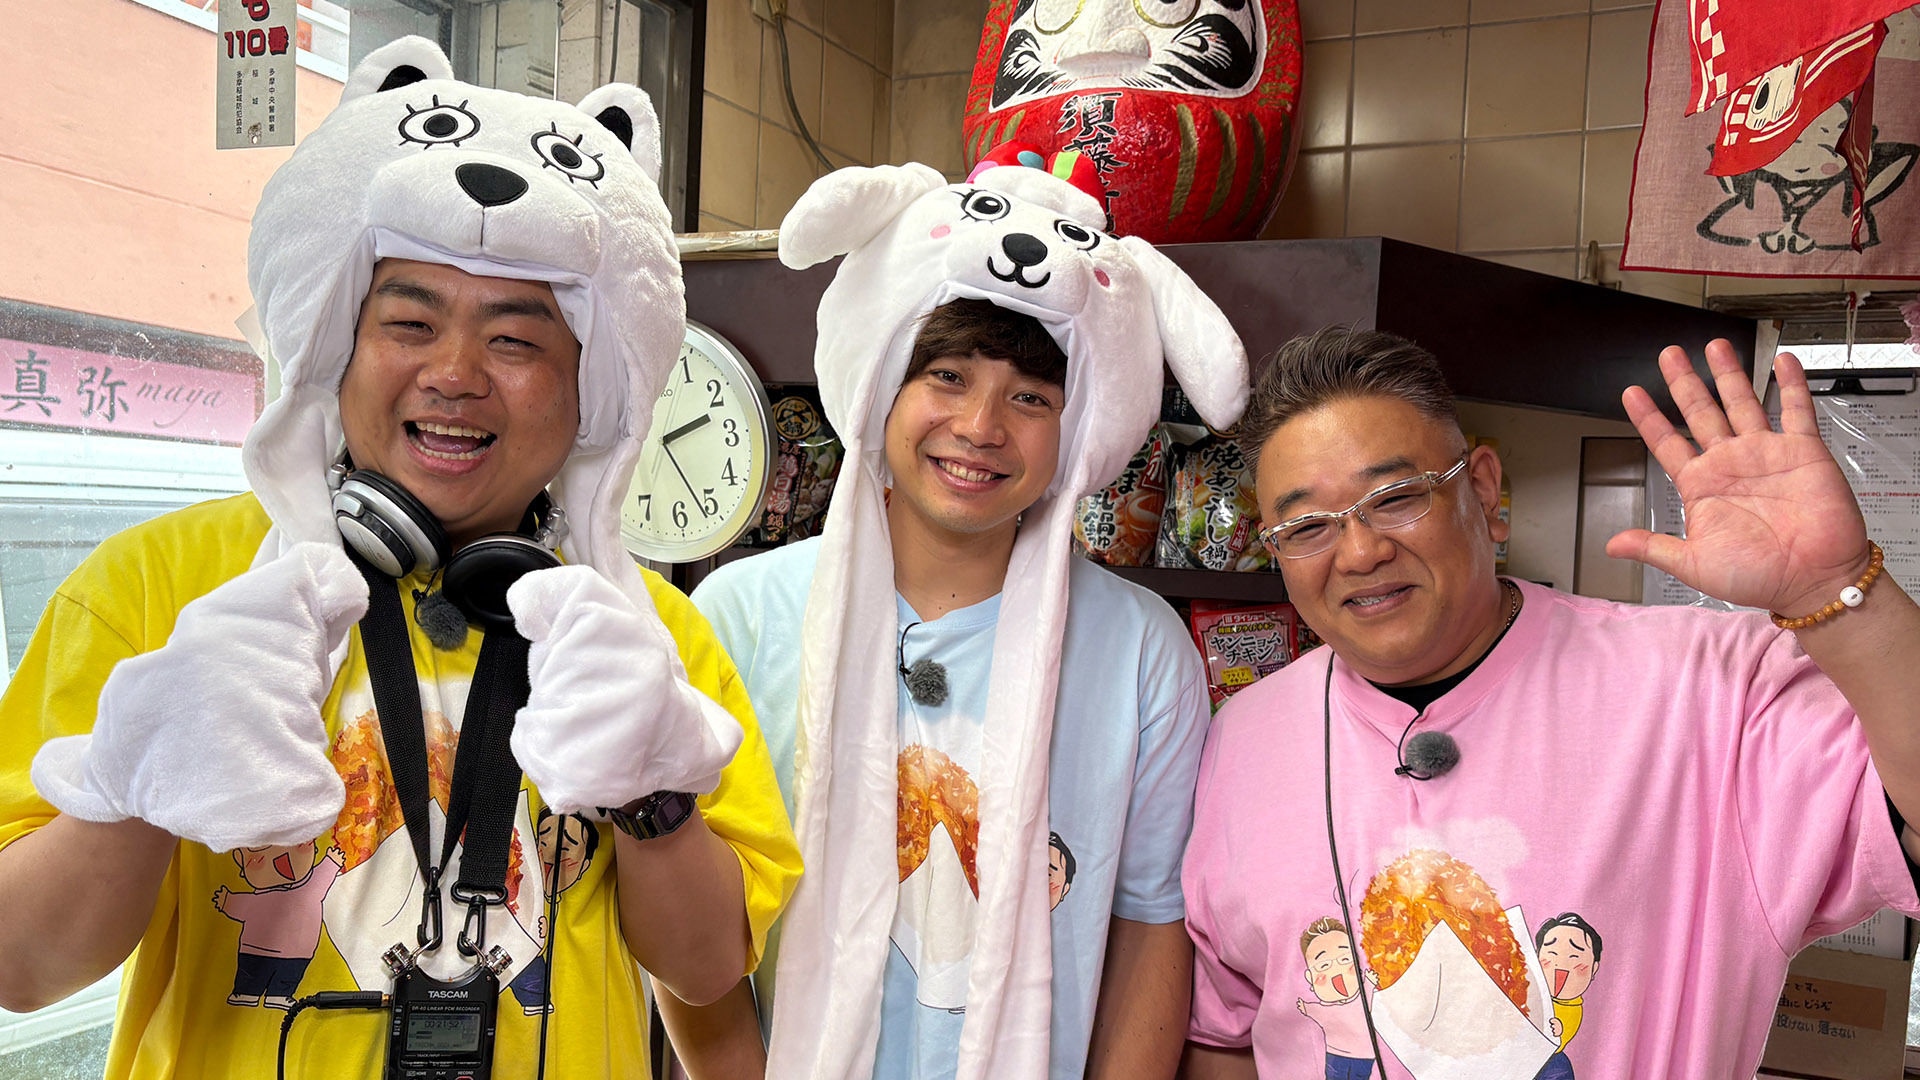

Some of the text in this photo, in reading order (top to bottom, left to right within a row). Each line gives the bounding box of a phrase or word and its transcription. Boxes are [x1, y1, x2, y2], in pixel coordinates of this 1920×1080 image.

[223, 26, 289, 59] 110番
[679, 356, 694, 384] 1
[136, 381, 226, 428] maya
[706, 379, 725, 408] 2
[723, 418, 740, 447] 3
[721, 457, 738, 486] 4
[638, 494, 651, 522] 7
[672, 501, 688, 529] 6
[702, 488, 719, 515] 5
[1211, 631, 1281, 651] ヤンニョム
[428, 990, 469, 999] TASCAM
